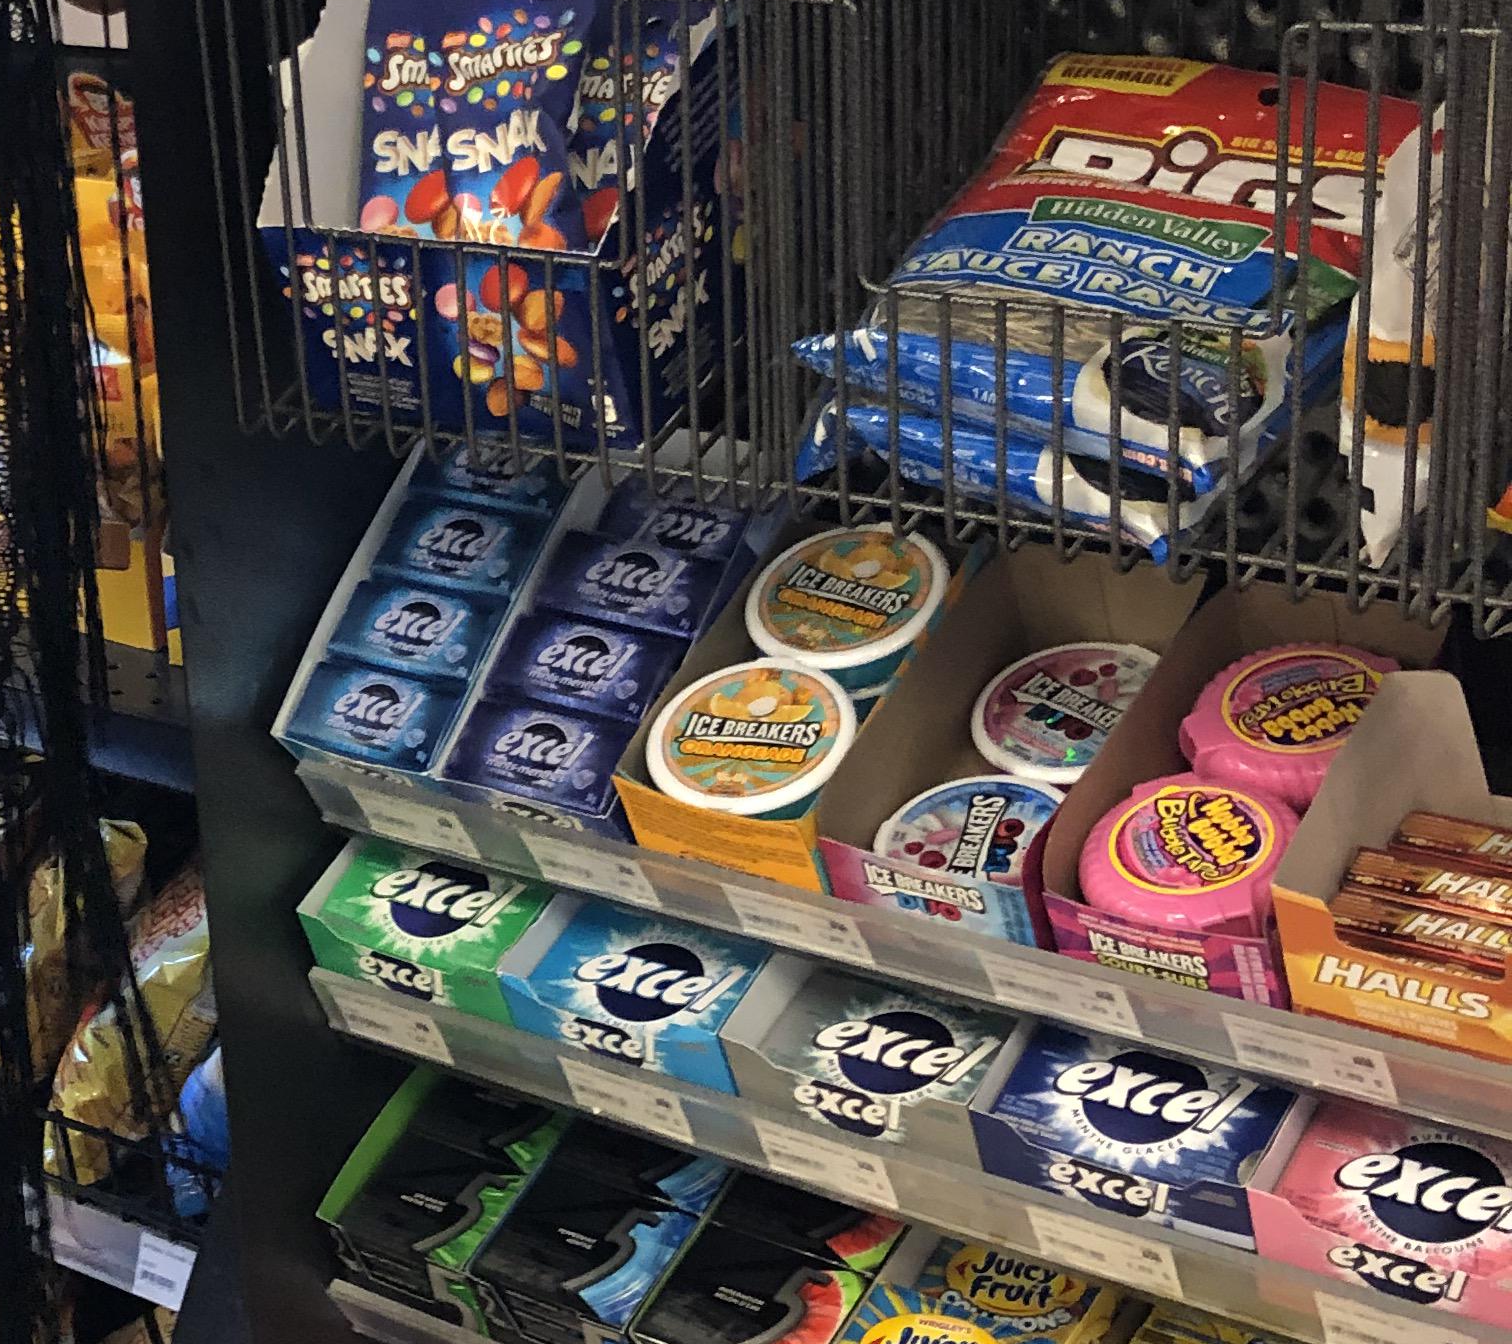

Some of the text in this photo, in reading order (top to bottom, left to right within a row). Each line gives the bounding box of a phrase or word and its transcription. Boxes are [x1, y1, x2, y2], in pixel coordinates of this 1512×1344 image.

[445, 30, 565, 94] SMARTIES
[446, 107, 548, 175] SNAX
[1050, 197, 1251, 259] Hidden Valley
[1016, 229, 1214, 290] RANCH
[901, 250, 1293, 333] SAUCE RANCH
[584, 559, 688, 606] excel
[791, 562, 909, 615] ICE BREAKERS
[374, 609, 467, 644] excel
[538, 642, 639, 680] excel
[1022, 672, 1053, 698] ICE
[333, 692, 425, 729] excel
[688, 713, 821, 746] ICE BREAKERS
[495, 731, 594, 769] excel
[372, 868, 528, 928] excel
[865, 862, 986, 915] ICE BREAKERS
[358, 955, 445, 997] excel
[1088, 929, 1209, 979] ICE BREAKERS
[575, 951, 744, 1013] excel
[1316, 955, 1494, 1022] HALLS
[560, 1019, 656, 1063] excel
[813, 1020, 1003, 1086] excel
[793, 1084, 901, 1131] excel
[1053, 1060, 1261, 1134] excel
[1047, 1160, 1170, 1213] excel
[967, 1273, 1055, 1309] Fruit
[1327, 1244, 1471, 1303] excel
